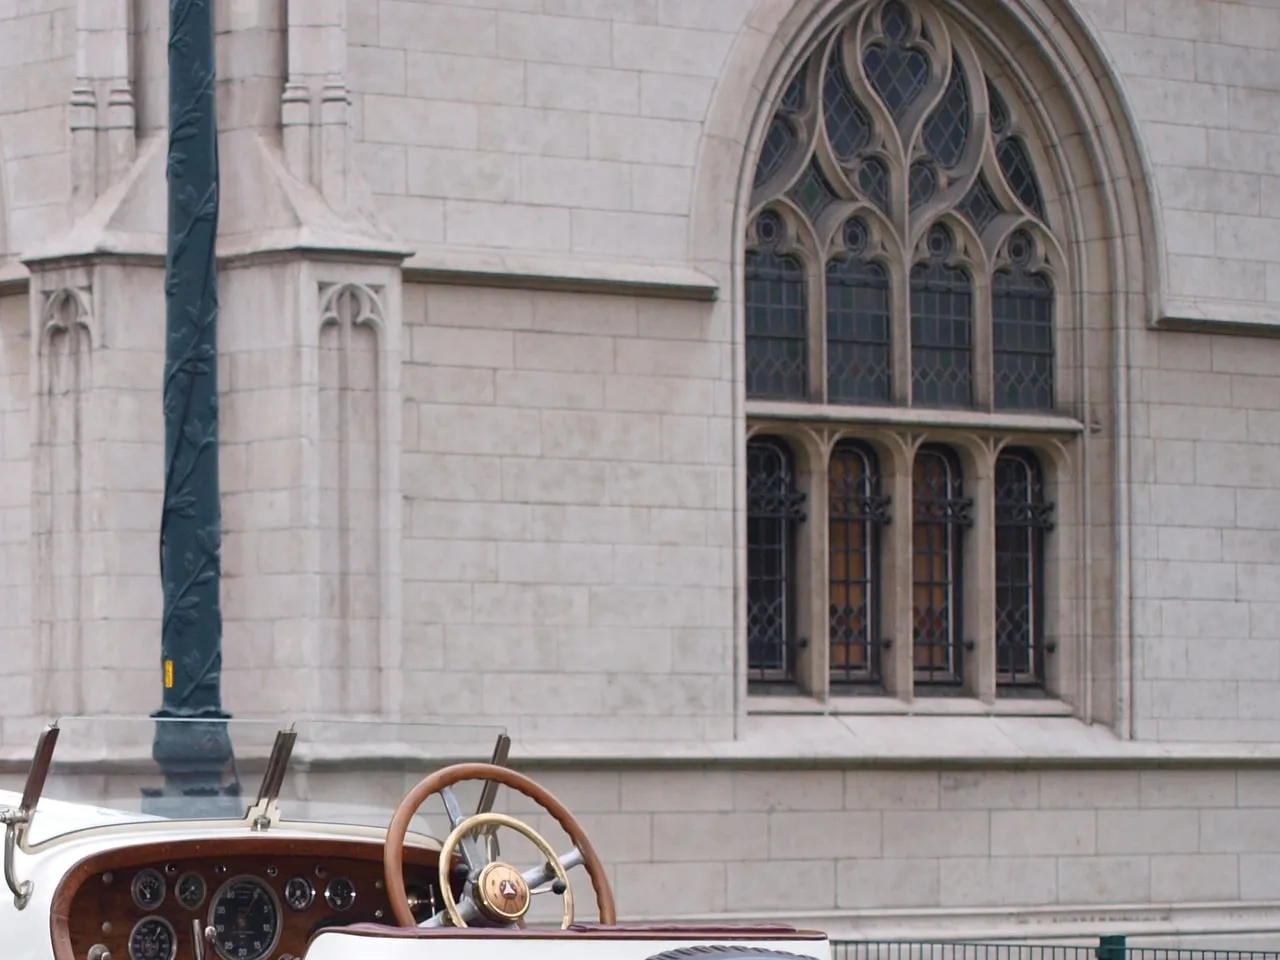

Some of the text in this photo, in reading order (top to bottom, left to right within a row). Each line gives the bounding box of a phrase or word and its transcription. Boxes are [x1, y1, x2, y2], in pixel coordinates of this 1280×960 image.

[224, 941, 233, 949] 25
[254, 941, 261, 949] 15
[238, 948, 247, 956] 20
